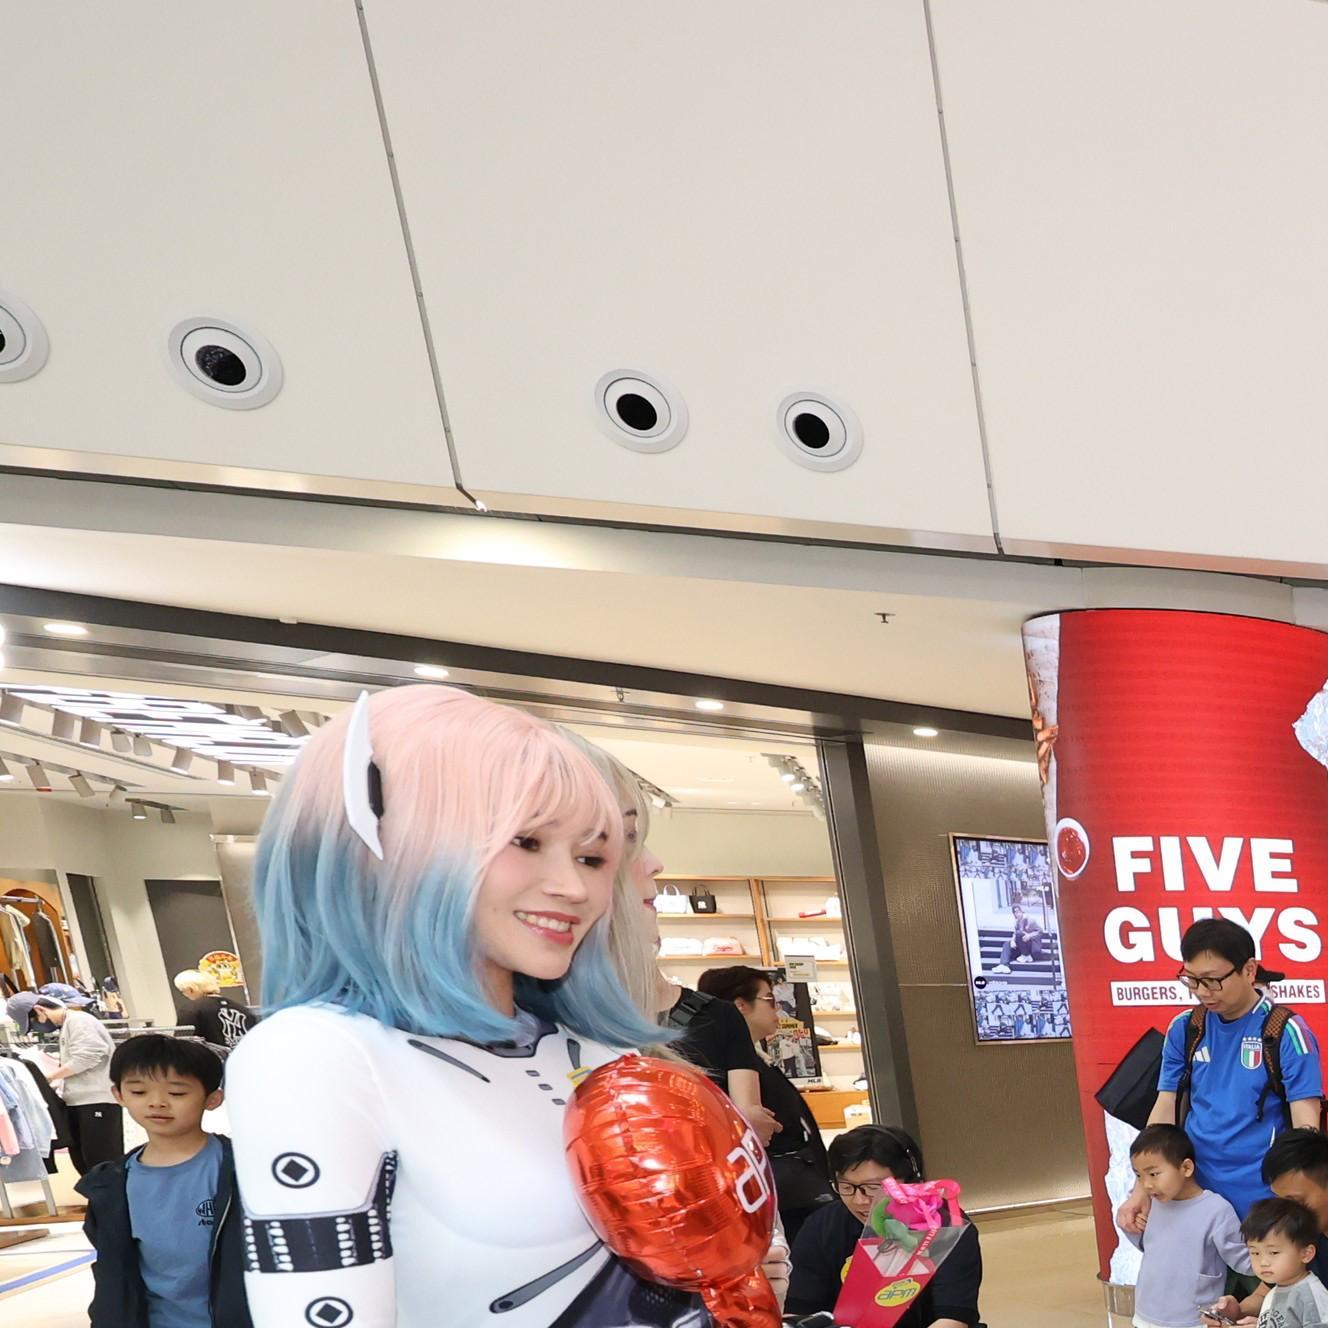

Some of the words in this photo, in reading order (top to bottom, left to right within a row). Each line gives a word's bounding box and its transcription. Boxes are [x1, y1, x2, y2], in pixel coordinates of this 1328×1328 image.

[1111, 835, 1299, 893] FIVE
[1103, 905, 1323, 964] GUYS
[1116, 985, 1184, 1002] BURGERS,
[1271, 984, 1321, 999] SHAKES
